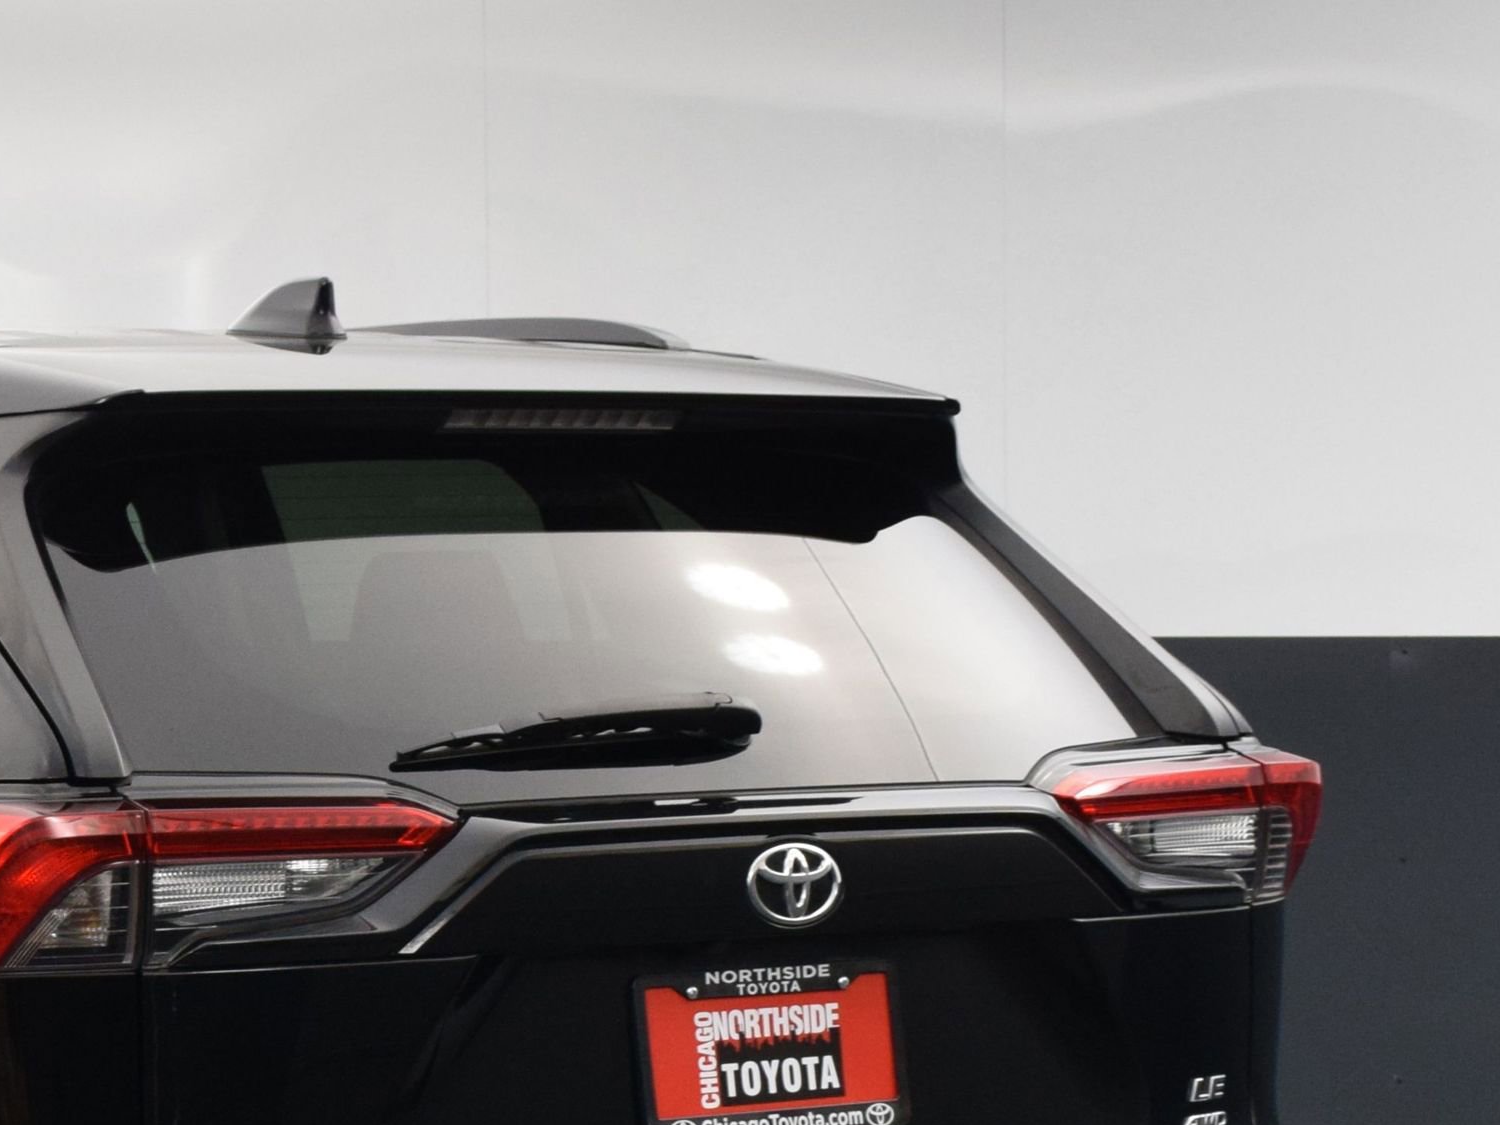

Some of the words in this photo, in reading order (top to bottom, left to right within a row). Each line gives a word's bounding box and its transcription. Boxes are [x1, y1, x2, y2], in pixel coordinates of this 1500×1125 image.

[704, 963, 831, 986] NORTHSIDE
[735, 979, 802, 996] TOYOTA
[712, 1003, 840, 1041] NORTHSIDE
[693, 1010, 722, 1110] CHICAGO
[721, 1055, 841, 1098] TOYOTA
[1189, 1073, 1227, 1103] LE
